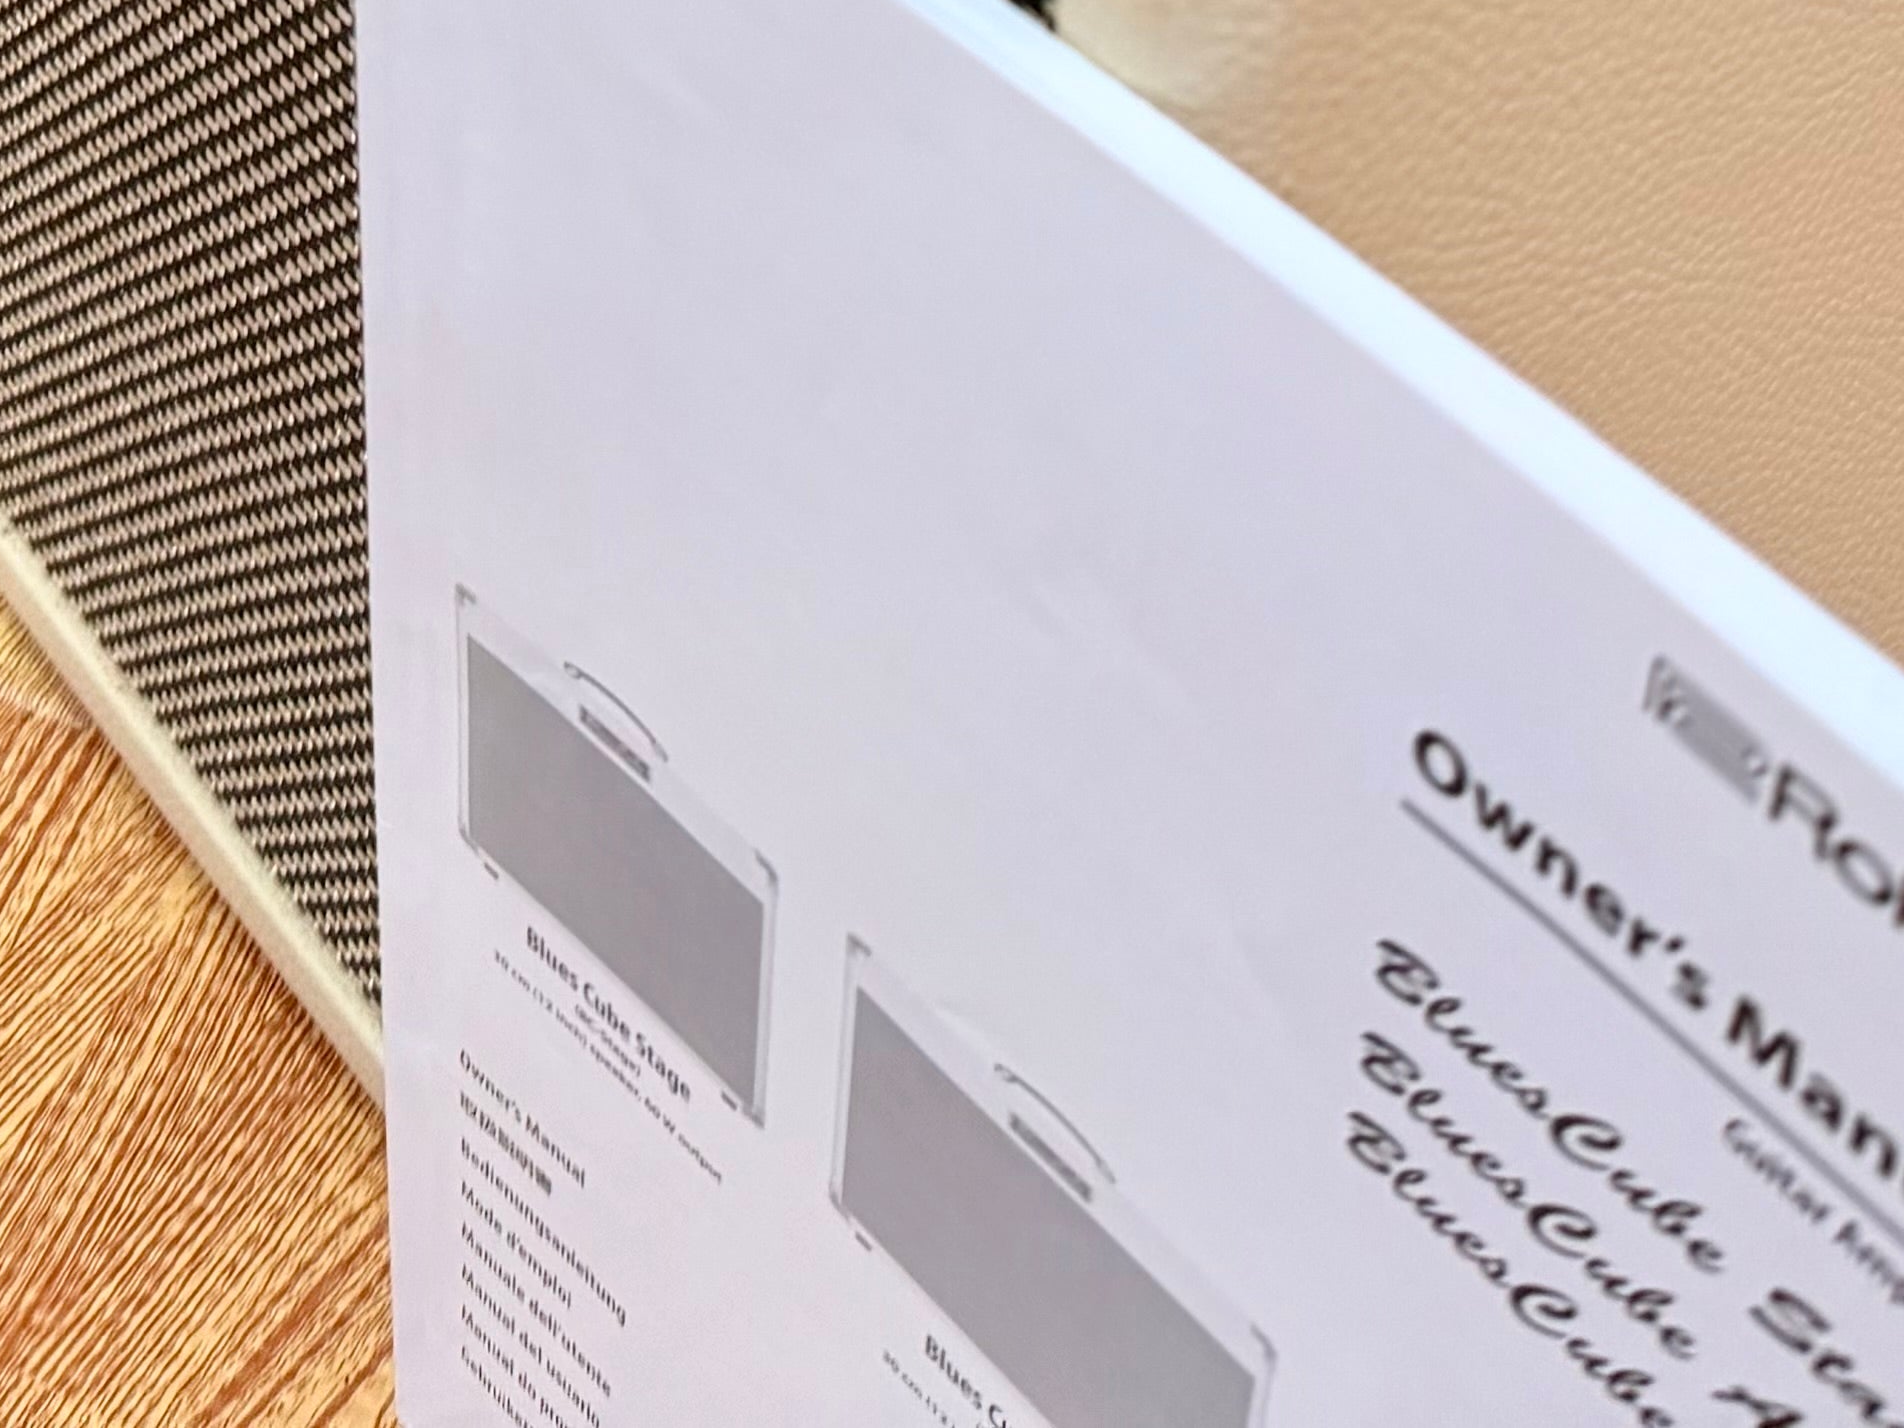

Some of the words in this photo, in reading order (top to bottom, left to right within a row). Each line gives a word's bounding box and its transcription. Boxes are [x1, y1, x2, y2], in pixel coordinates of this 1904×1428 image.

[1413, 728, 1711, 1011] Owner's
[526, 924, 580, 993] Blues
[582, 980, 631, 1044] Cube
[635, 1031, 692, 1104] Stage
[460, 1047, 522, 1123] Owner's
[525, 1113, 586, 1190] Manual
[461, 1179, 502, 1235] Mode
[461, 1220, 526, 1304] Manuale
[461, 1262, 516, 1336] Manual
[461, 1302, 515, 1377] Manual
[925, 1332, 983, 1411] Blues
